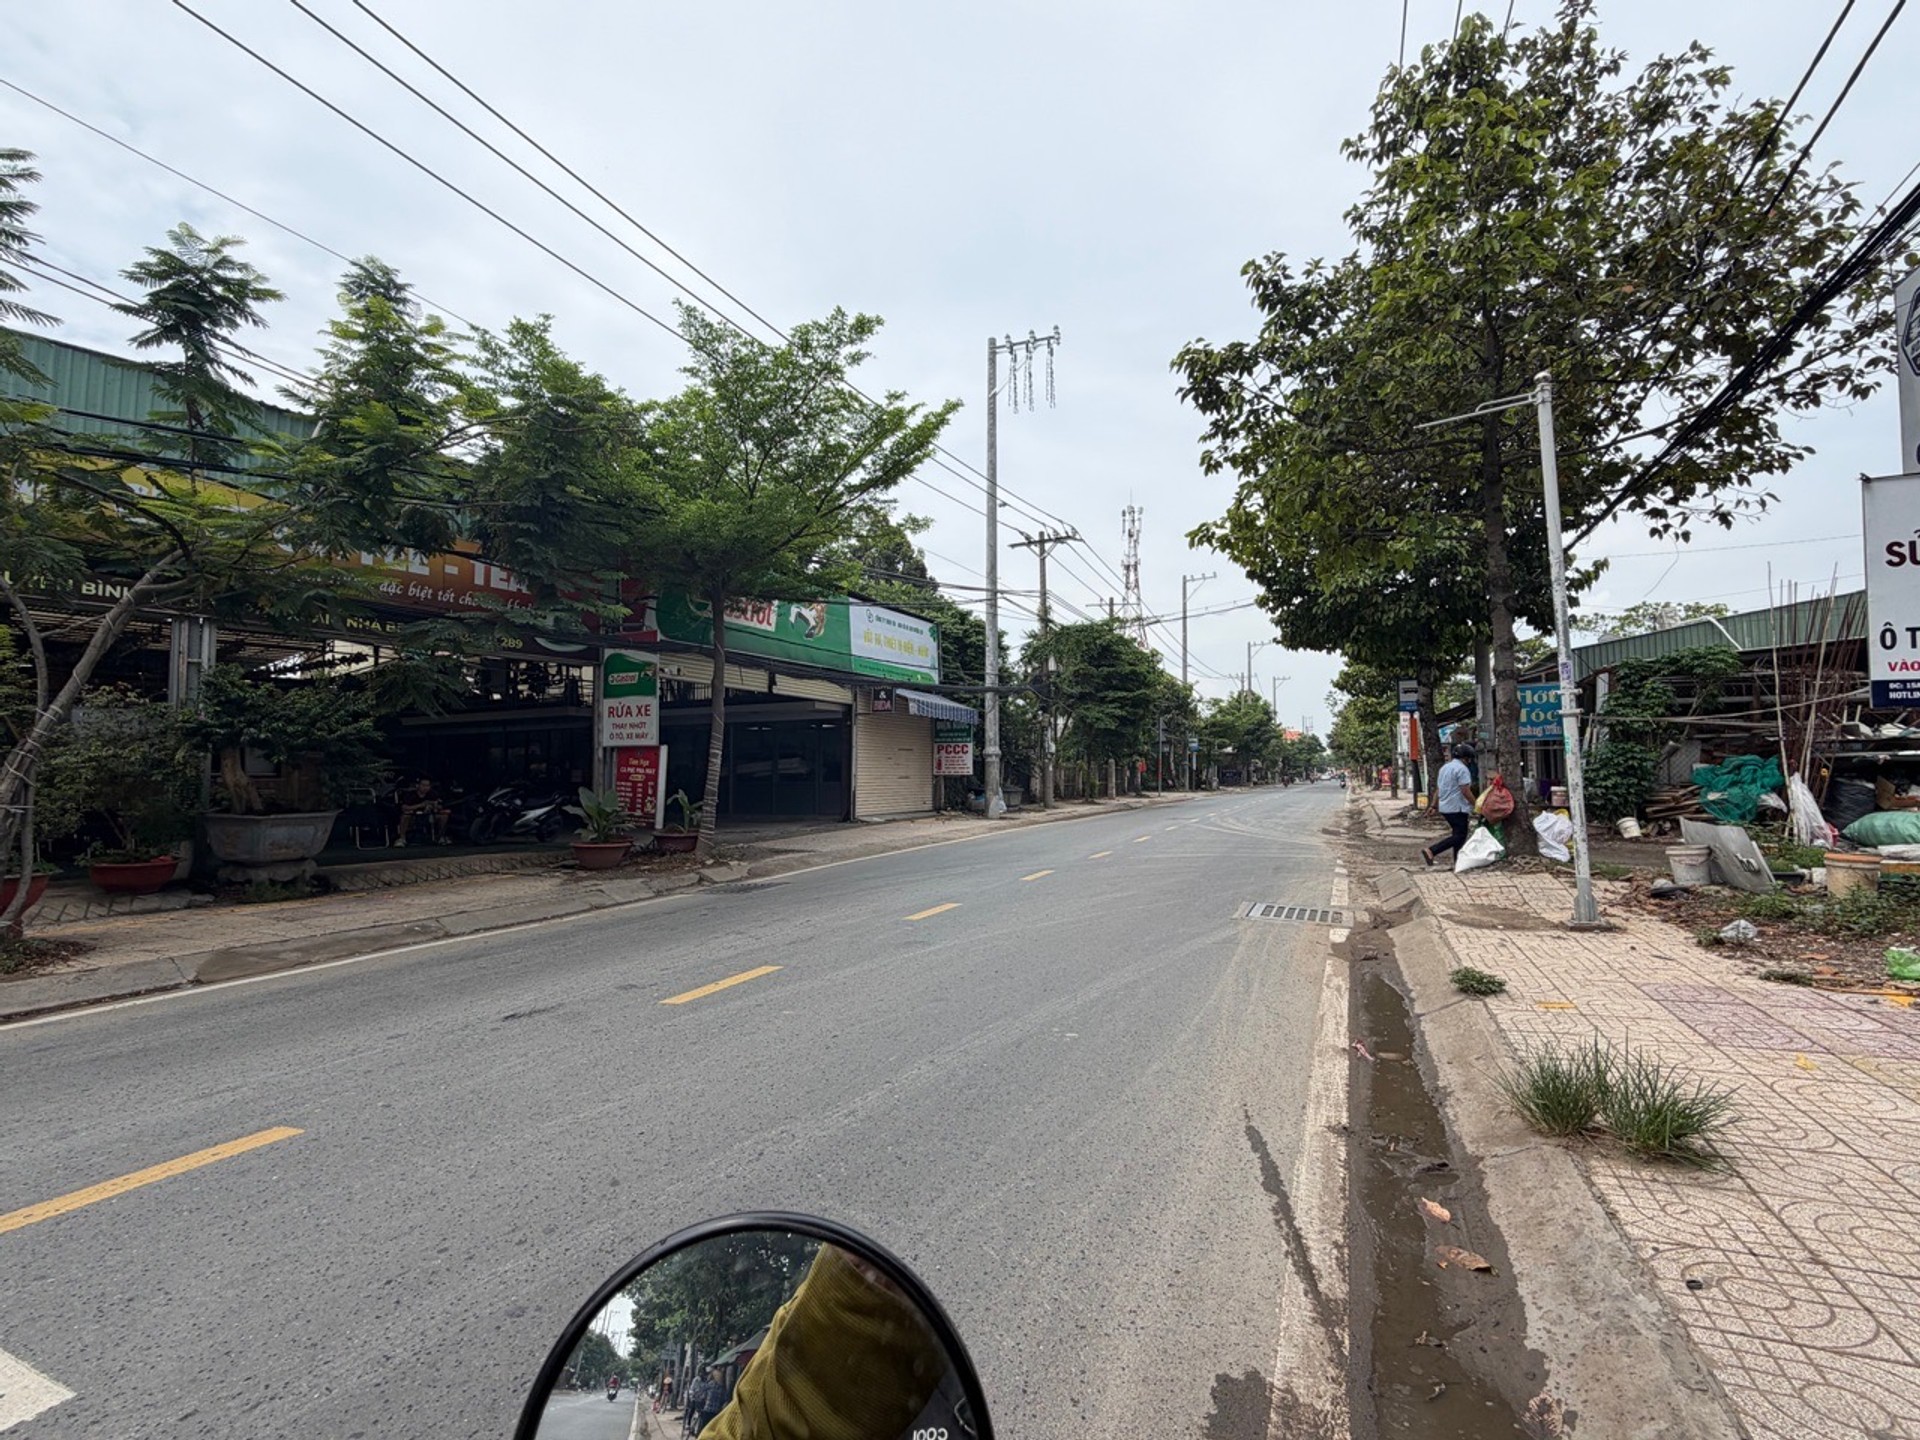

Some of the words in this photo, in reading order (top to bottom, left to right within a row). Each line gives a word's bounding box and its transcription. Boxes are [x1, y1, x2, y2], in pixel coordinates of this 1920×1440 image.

[408, 581, 433, 601] biệt
[437, 587, 455, 603] tốt
[1880, 621, 1897, 650] Ô
[608, 702, 632, 718] RỬA
[636, 704, 651, 717] XE
[937, 744, 969, 755] PCCC
